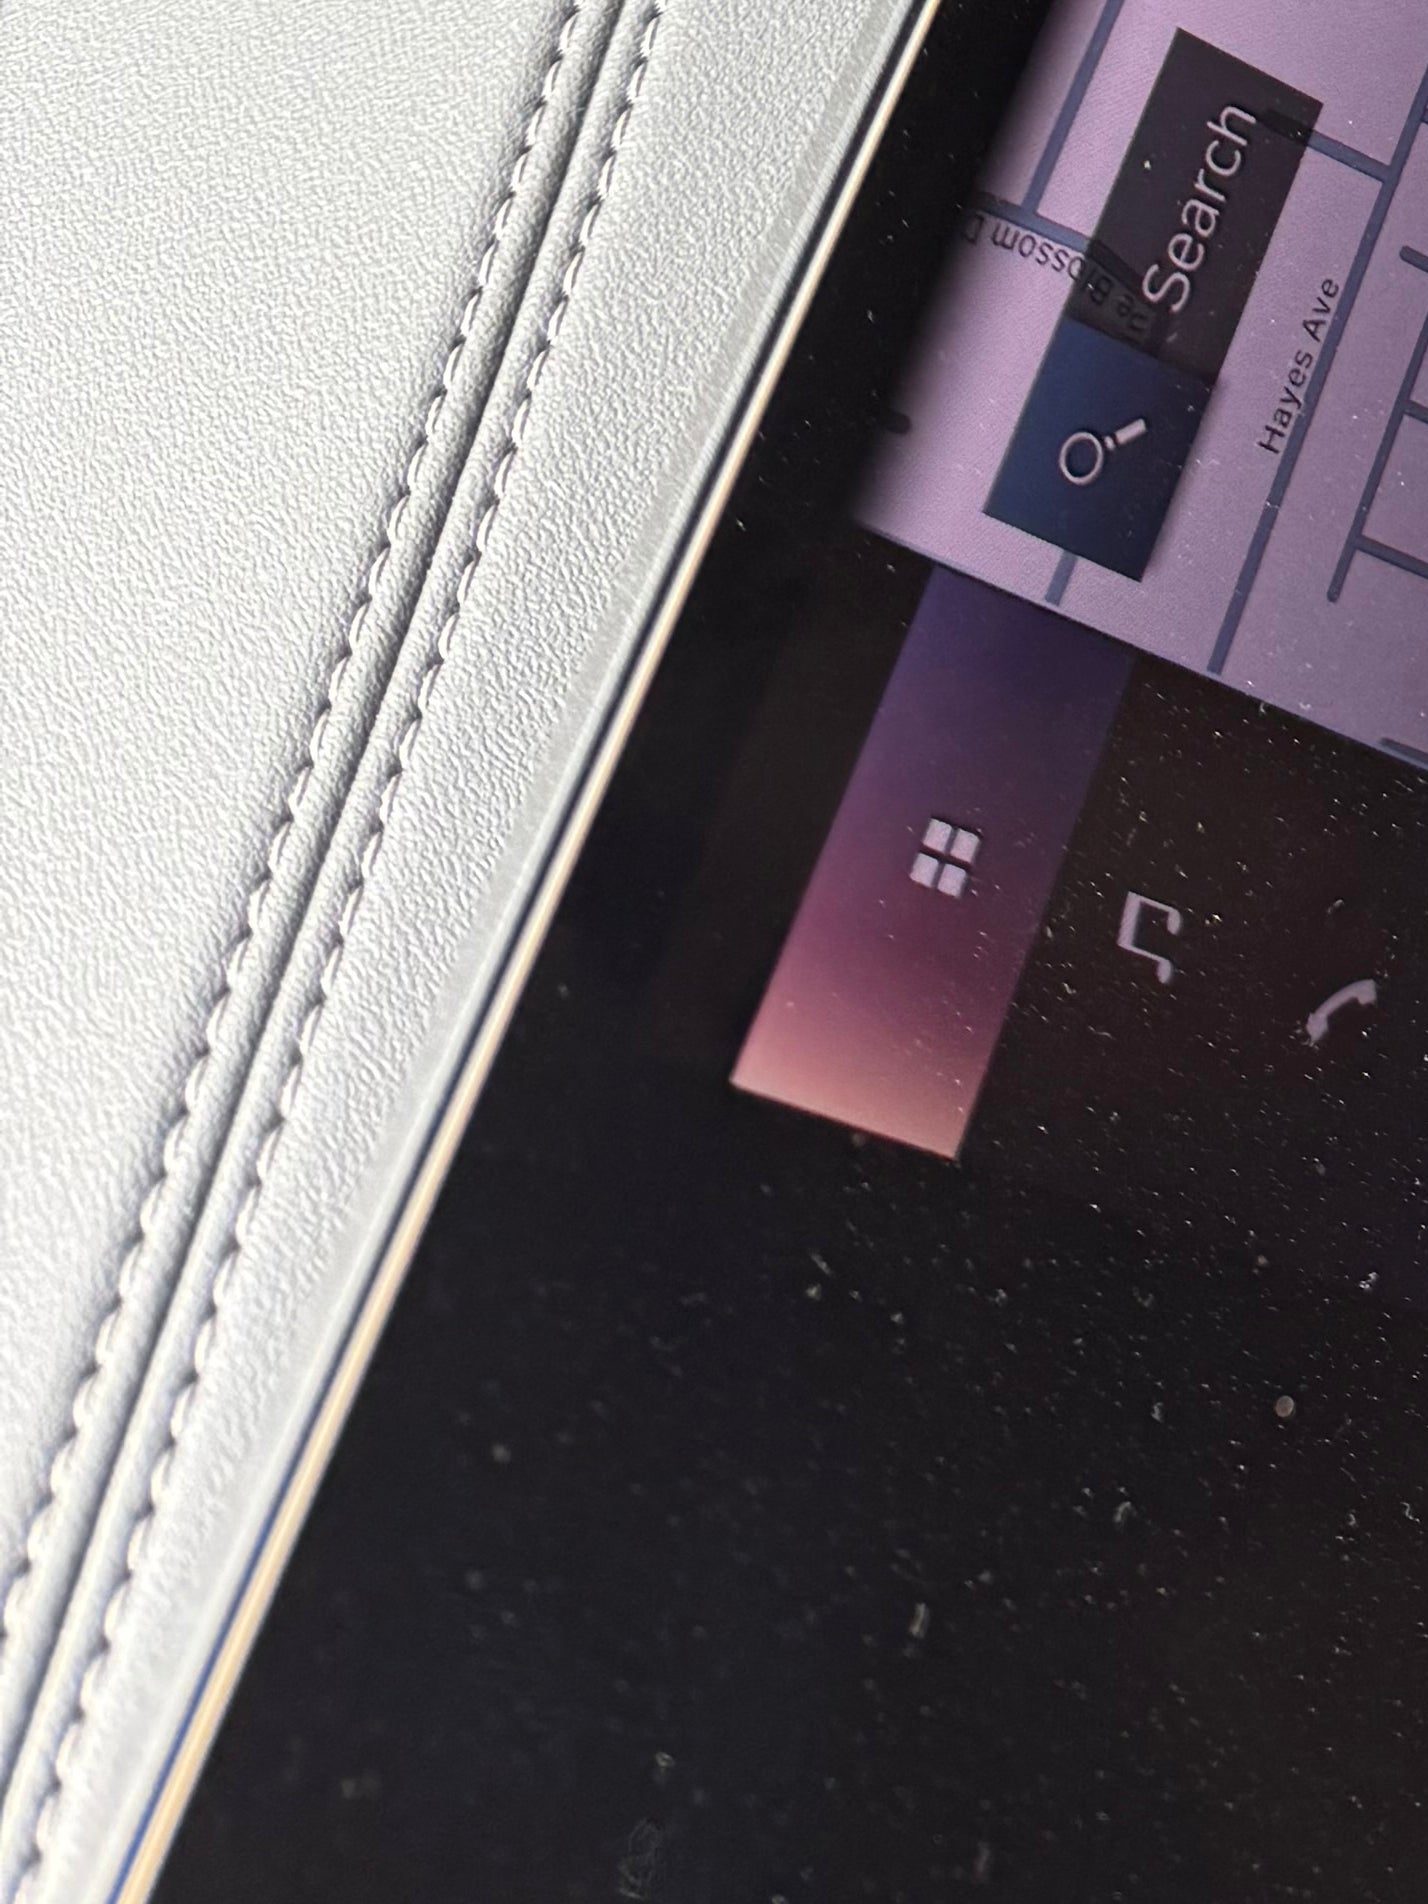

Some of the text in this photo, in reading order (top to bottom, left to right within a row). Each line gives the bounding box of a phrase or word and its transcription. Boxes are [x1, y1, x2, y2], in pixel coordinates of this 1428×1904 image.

[1140, 104, 1258, 316] Search
[1257, 278, 1340, 454] Hayes Ave
